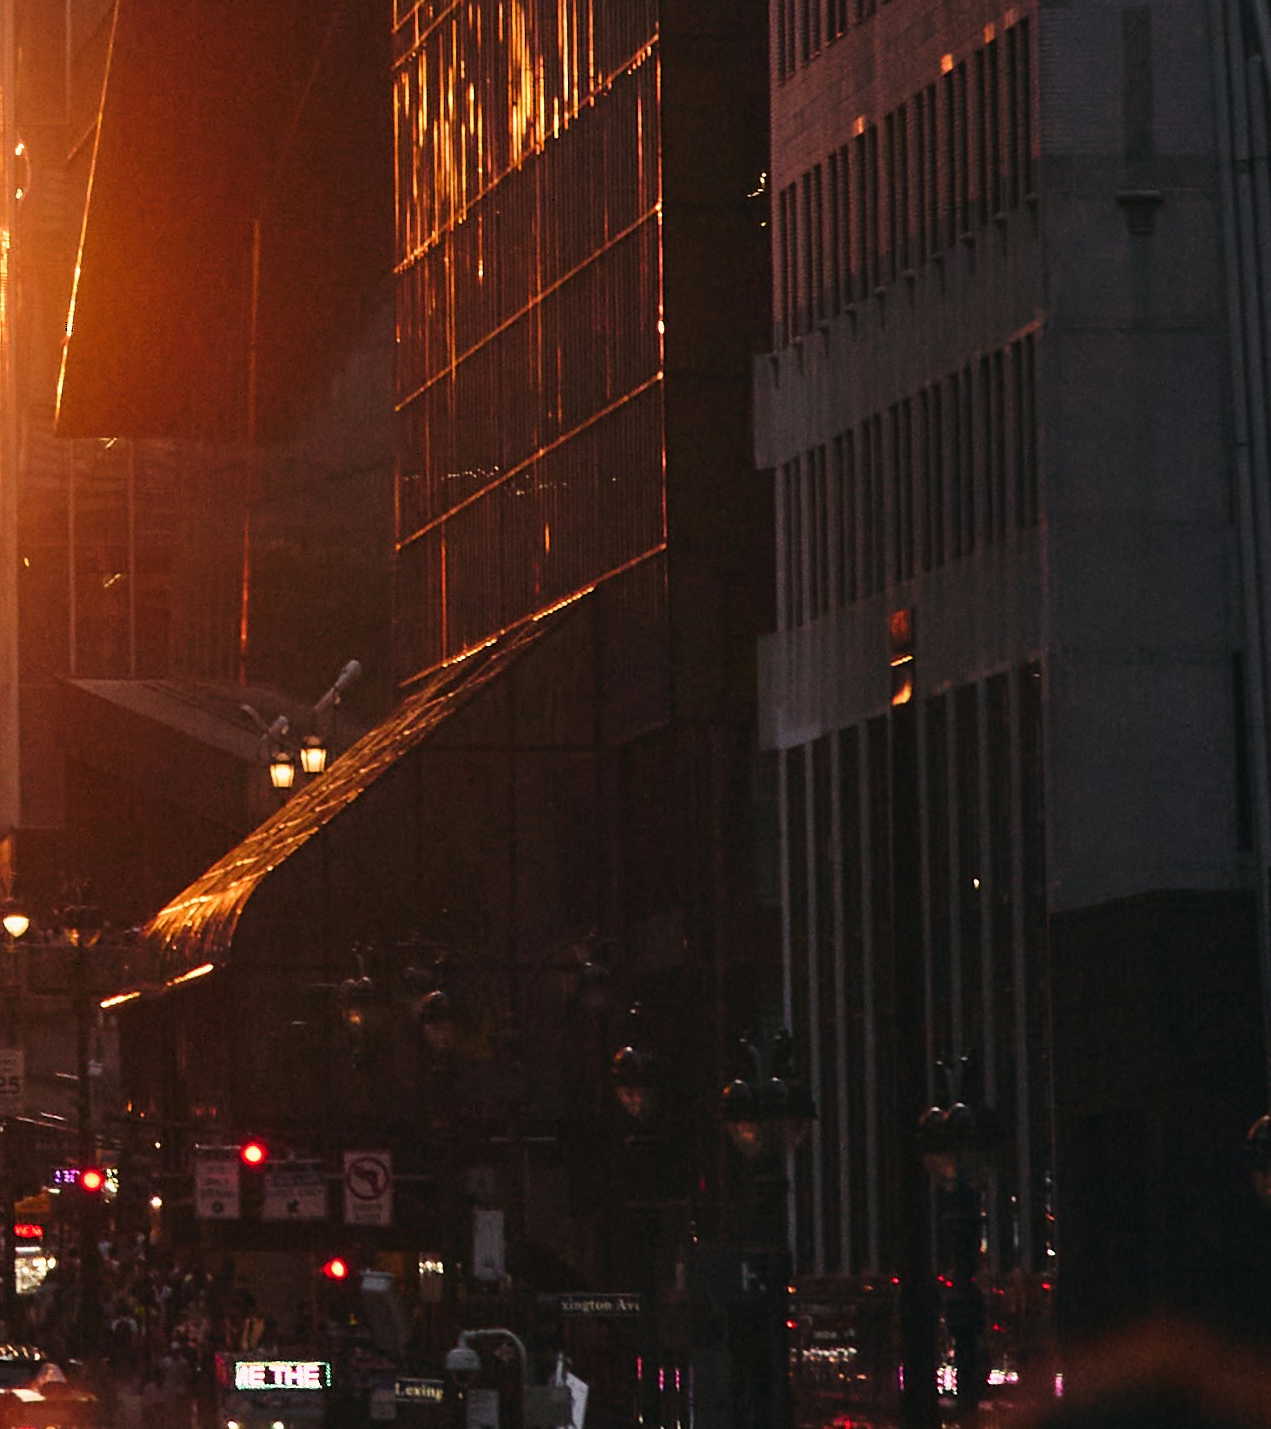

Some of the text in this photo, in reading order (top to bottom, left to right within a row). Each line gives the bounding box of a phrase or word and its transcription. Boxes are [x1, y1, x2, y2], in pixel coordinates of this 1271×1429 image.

[561, 1298, 612, 1313] xington
[269, 1364, 321, 1388] THE
[395, 1382, 443, 1402] Lexing
